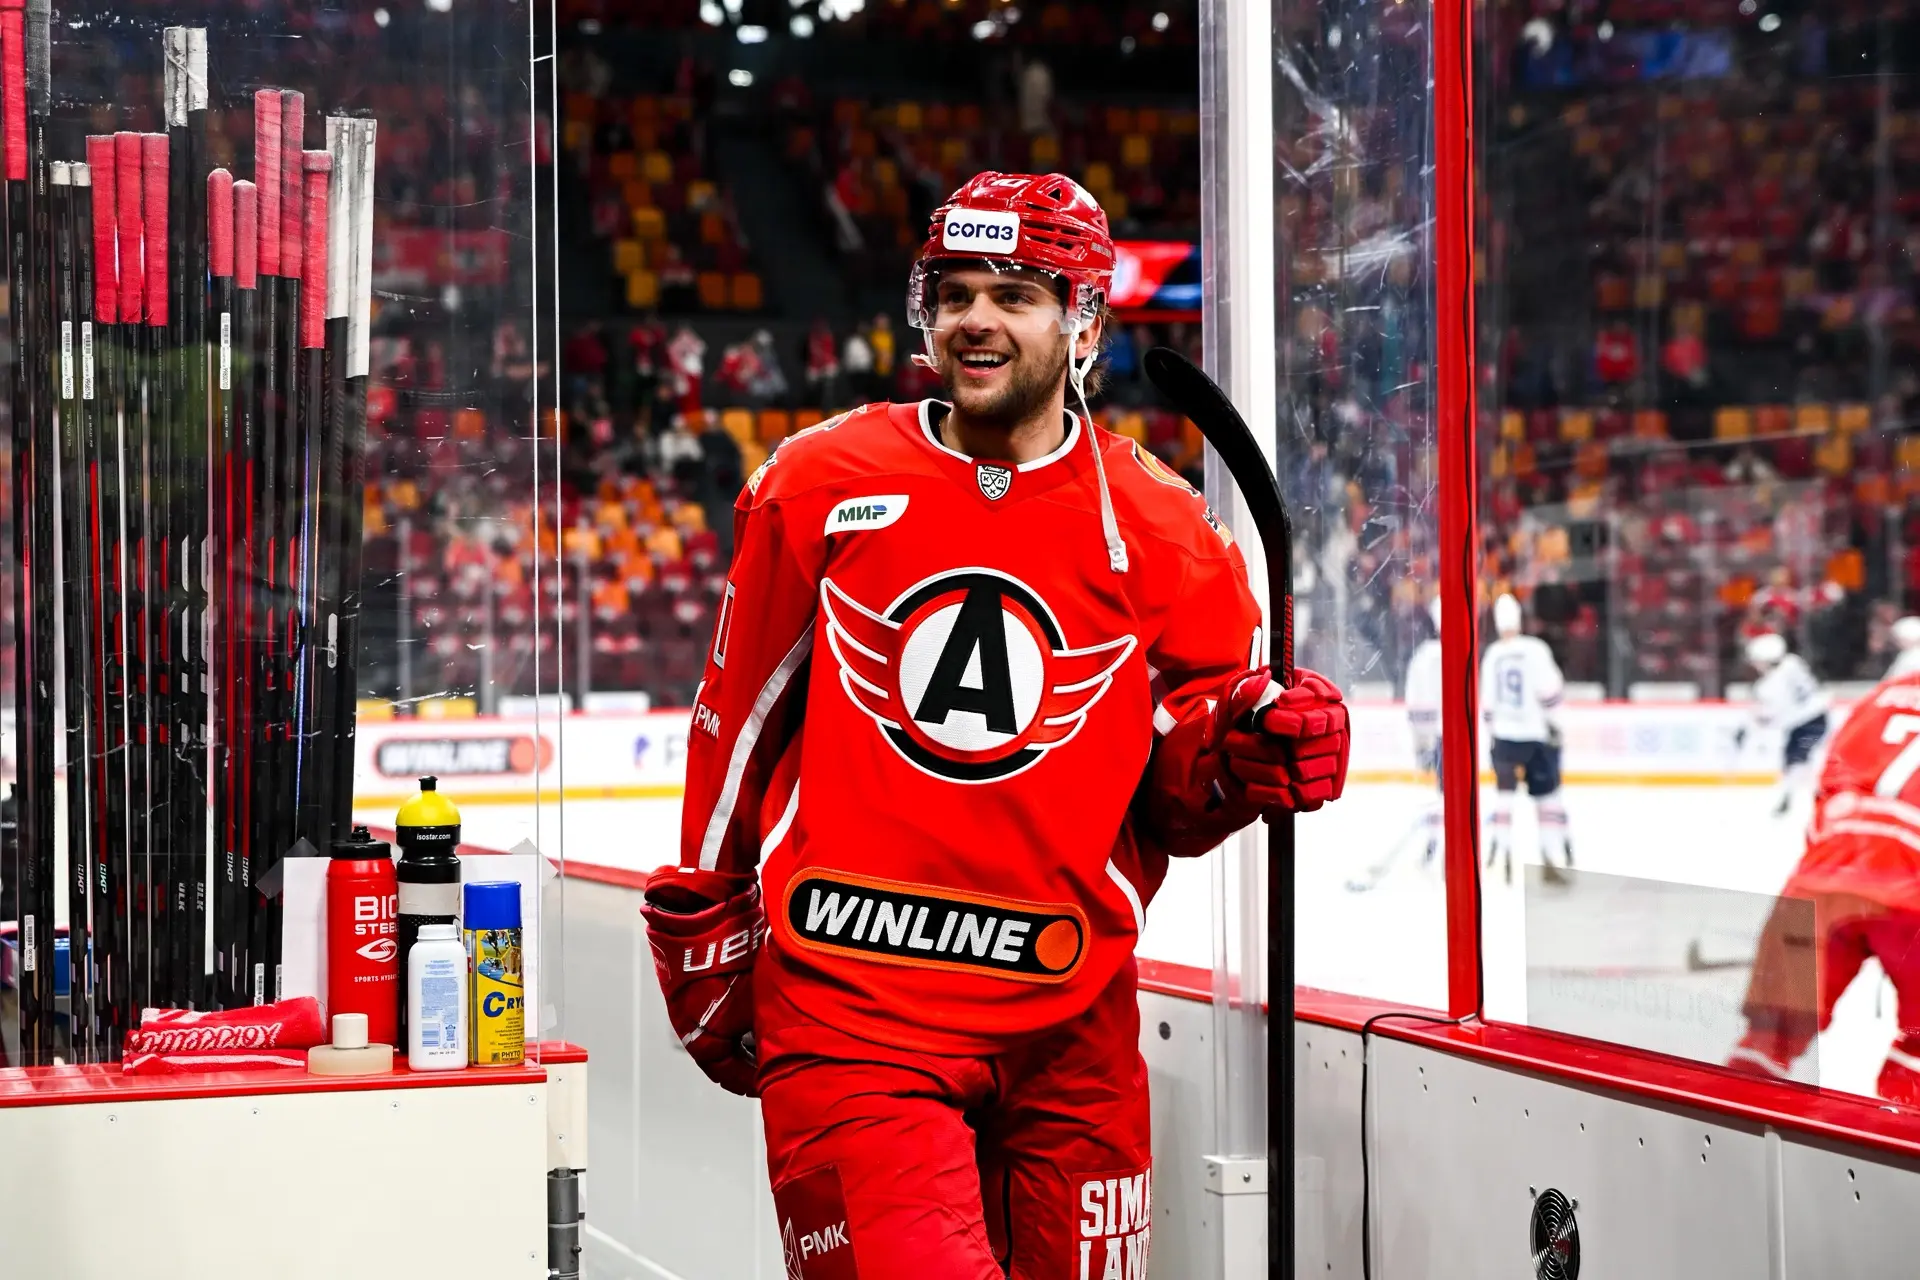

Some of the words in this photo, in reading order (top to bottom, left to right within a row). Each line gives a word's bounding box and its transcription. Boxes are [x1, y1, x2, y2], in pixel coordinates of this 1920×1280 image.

[947, 222, 1014, 241] согаз
[838, 505, 887, 522] МИР
[416, 833, 451, 841] isostar.com
[354, 922, 397, 936] STEE
[805, 888, 1031, 963] WINLINE
[354, 975, 380, 983] SPORTS
